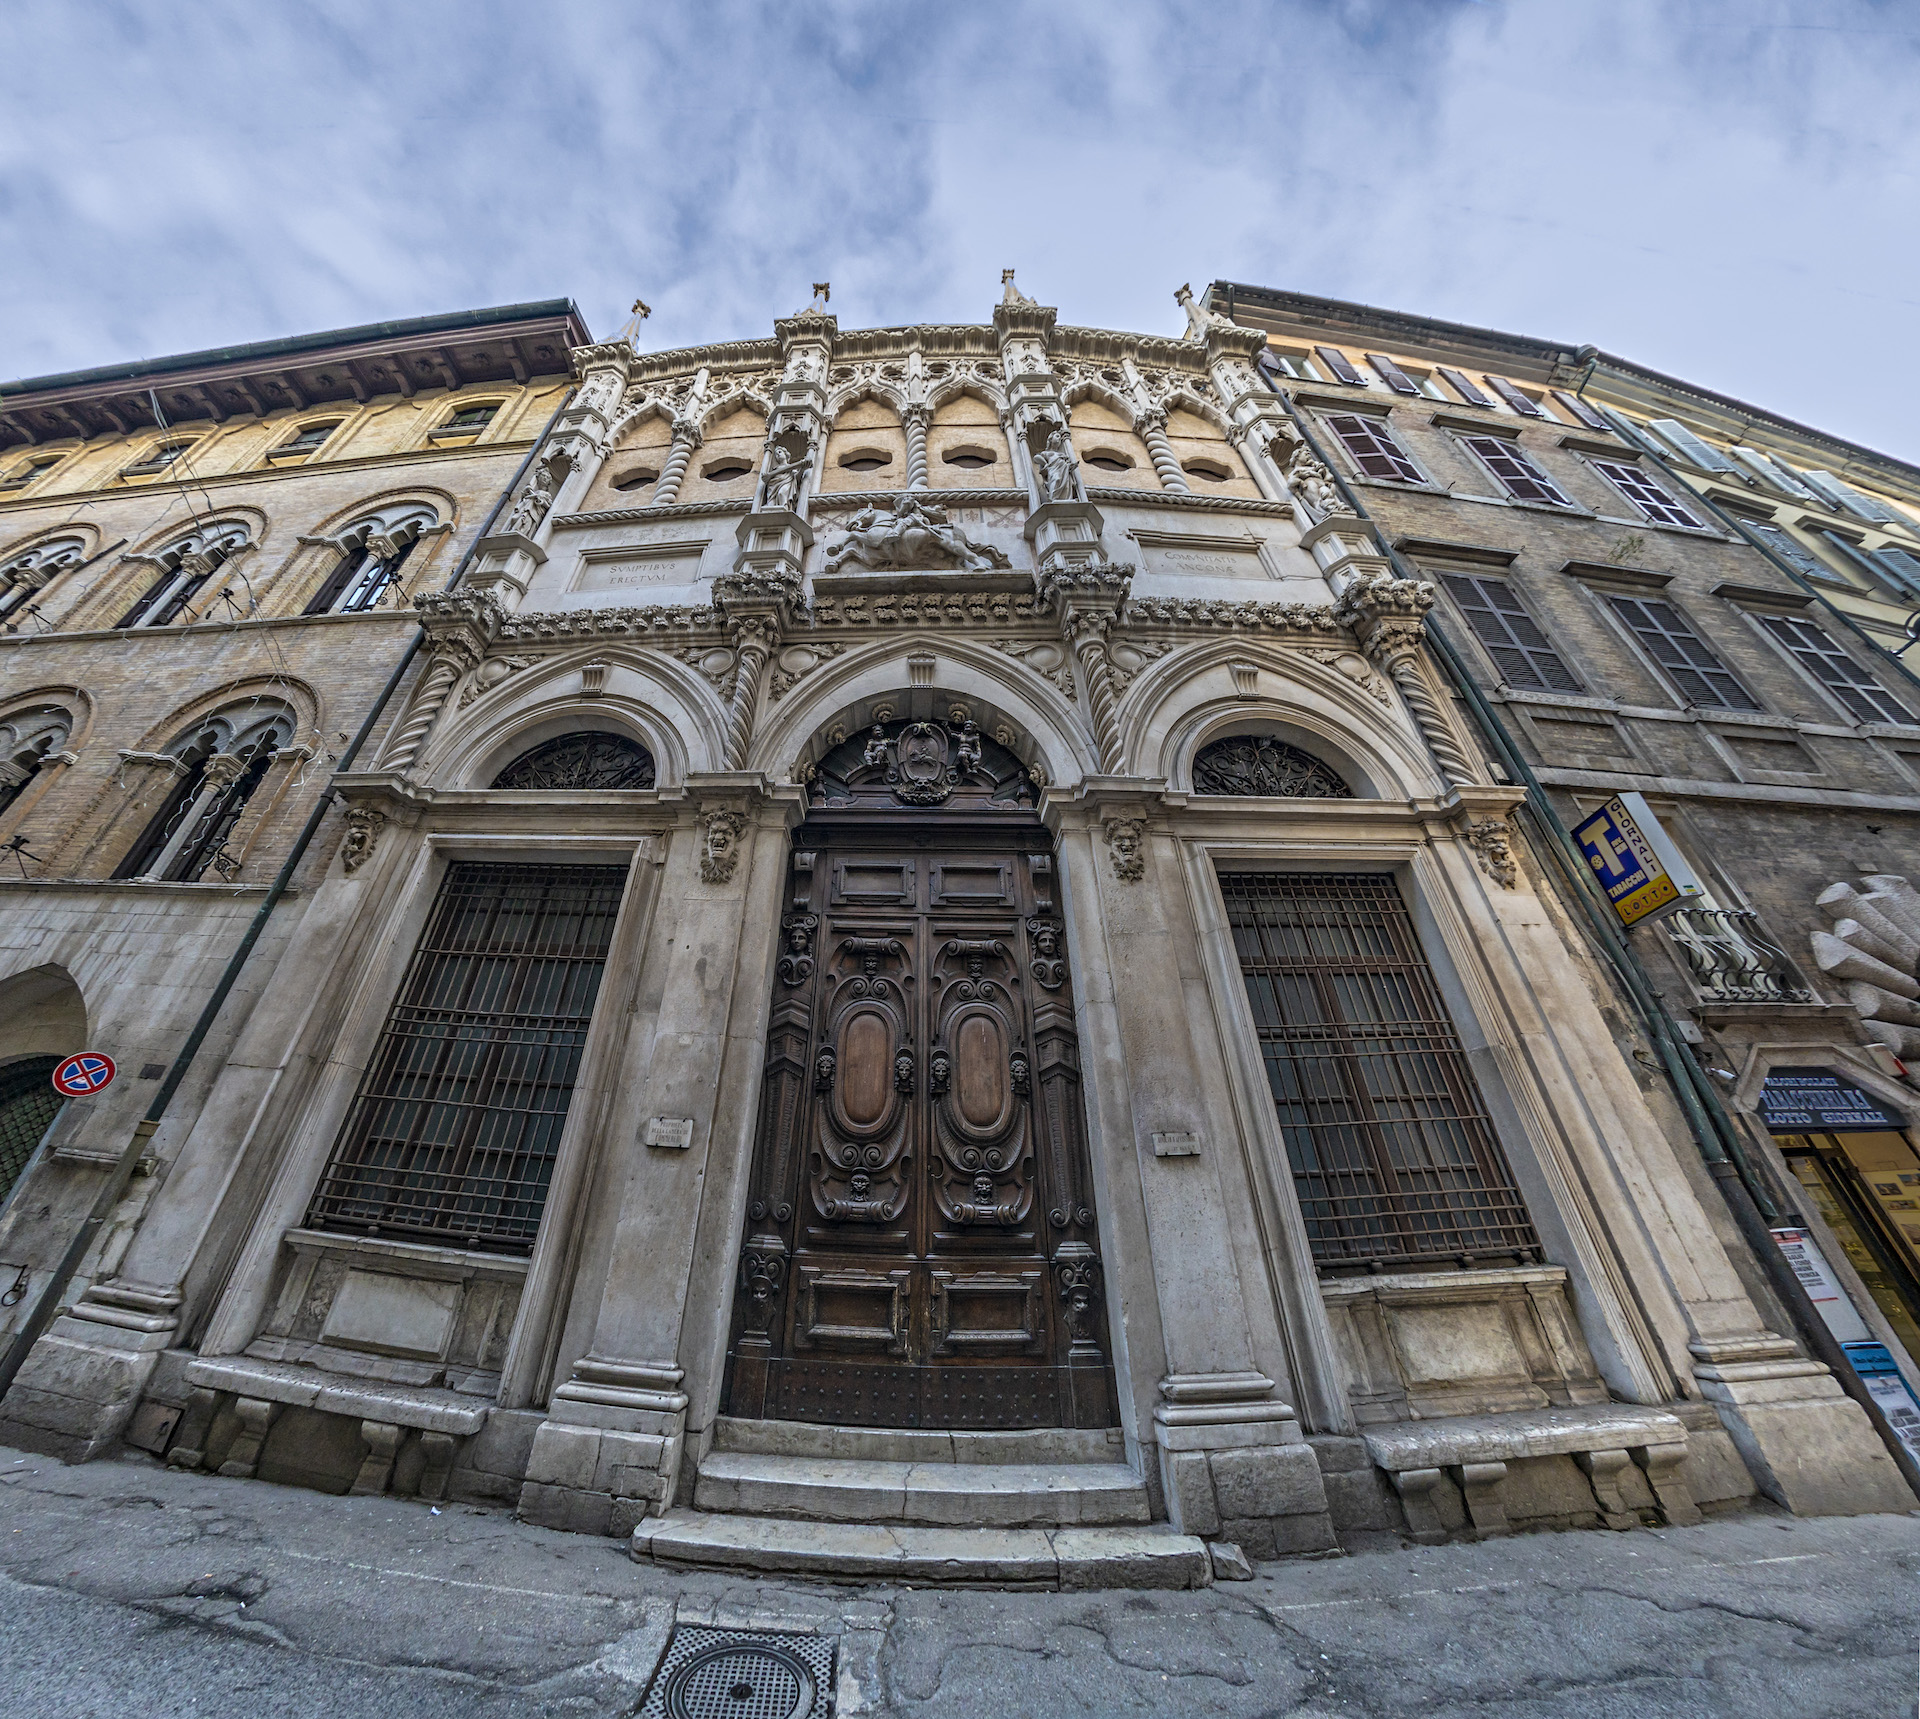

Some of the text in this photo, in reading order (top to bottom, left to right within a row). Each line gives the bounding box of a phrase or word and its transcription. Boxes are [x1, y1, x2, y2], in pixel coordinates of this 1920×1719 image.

[609, 563, 676, 574] SVMPTIBVS
[609, 574, 666, 585] ERECTVM
[1579, 816, 1625, 877] T
[1610, 801, 1657, 872] GIORNALI
[1607, 869, 1647, 898] TABACCHI
[1622, 883, 1671, 917] LOTTO
[1760, 1089, 1853, 1110] TABACCHERIA
[1764, 1111, 1889, 1124] LOTTO GIORNALI
